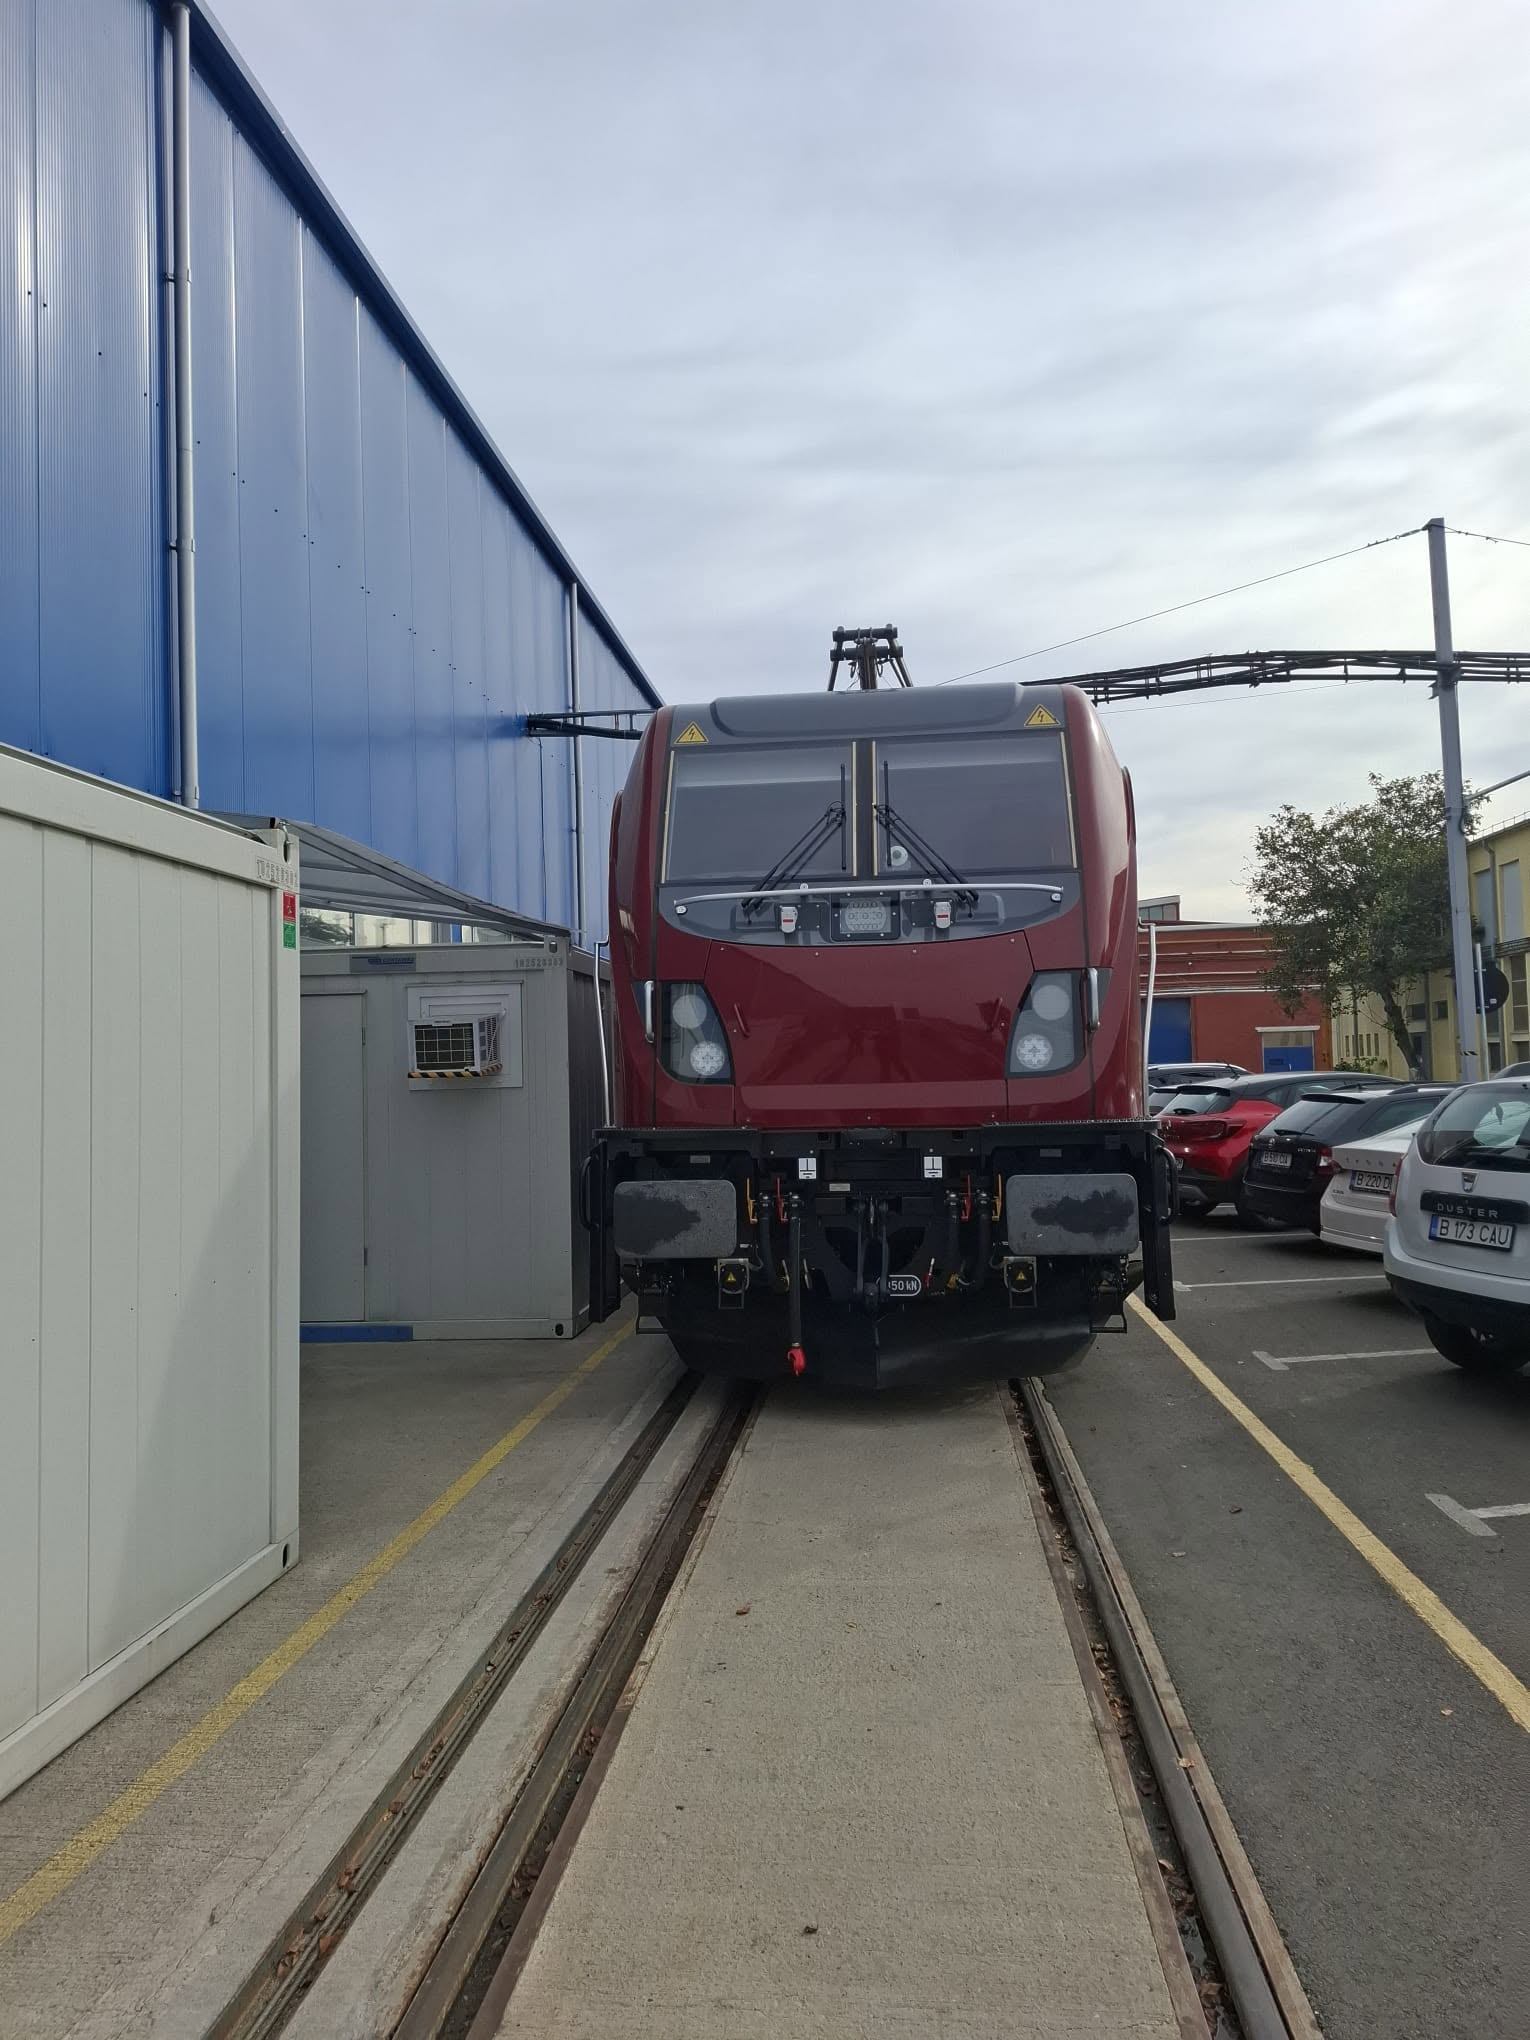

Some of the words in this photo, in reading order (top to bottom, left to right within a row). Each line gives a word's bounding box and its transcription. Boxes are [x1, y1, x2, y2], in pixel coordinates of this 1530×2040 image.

[1356, 1173, 1364, 1186] B
[1365, 1174, 1382, 1188] 220
[1383, 1176, 1392, 1190] D
[1437, 1203, 1498, 1218] DUSTER
[1440, 1220, 1449, 1236] B
[1455, 1221, 1475, 1240] 173
[1479, 1224, 1510, 1246] CAU
[906, 1280, 917, 1291] kN
